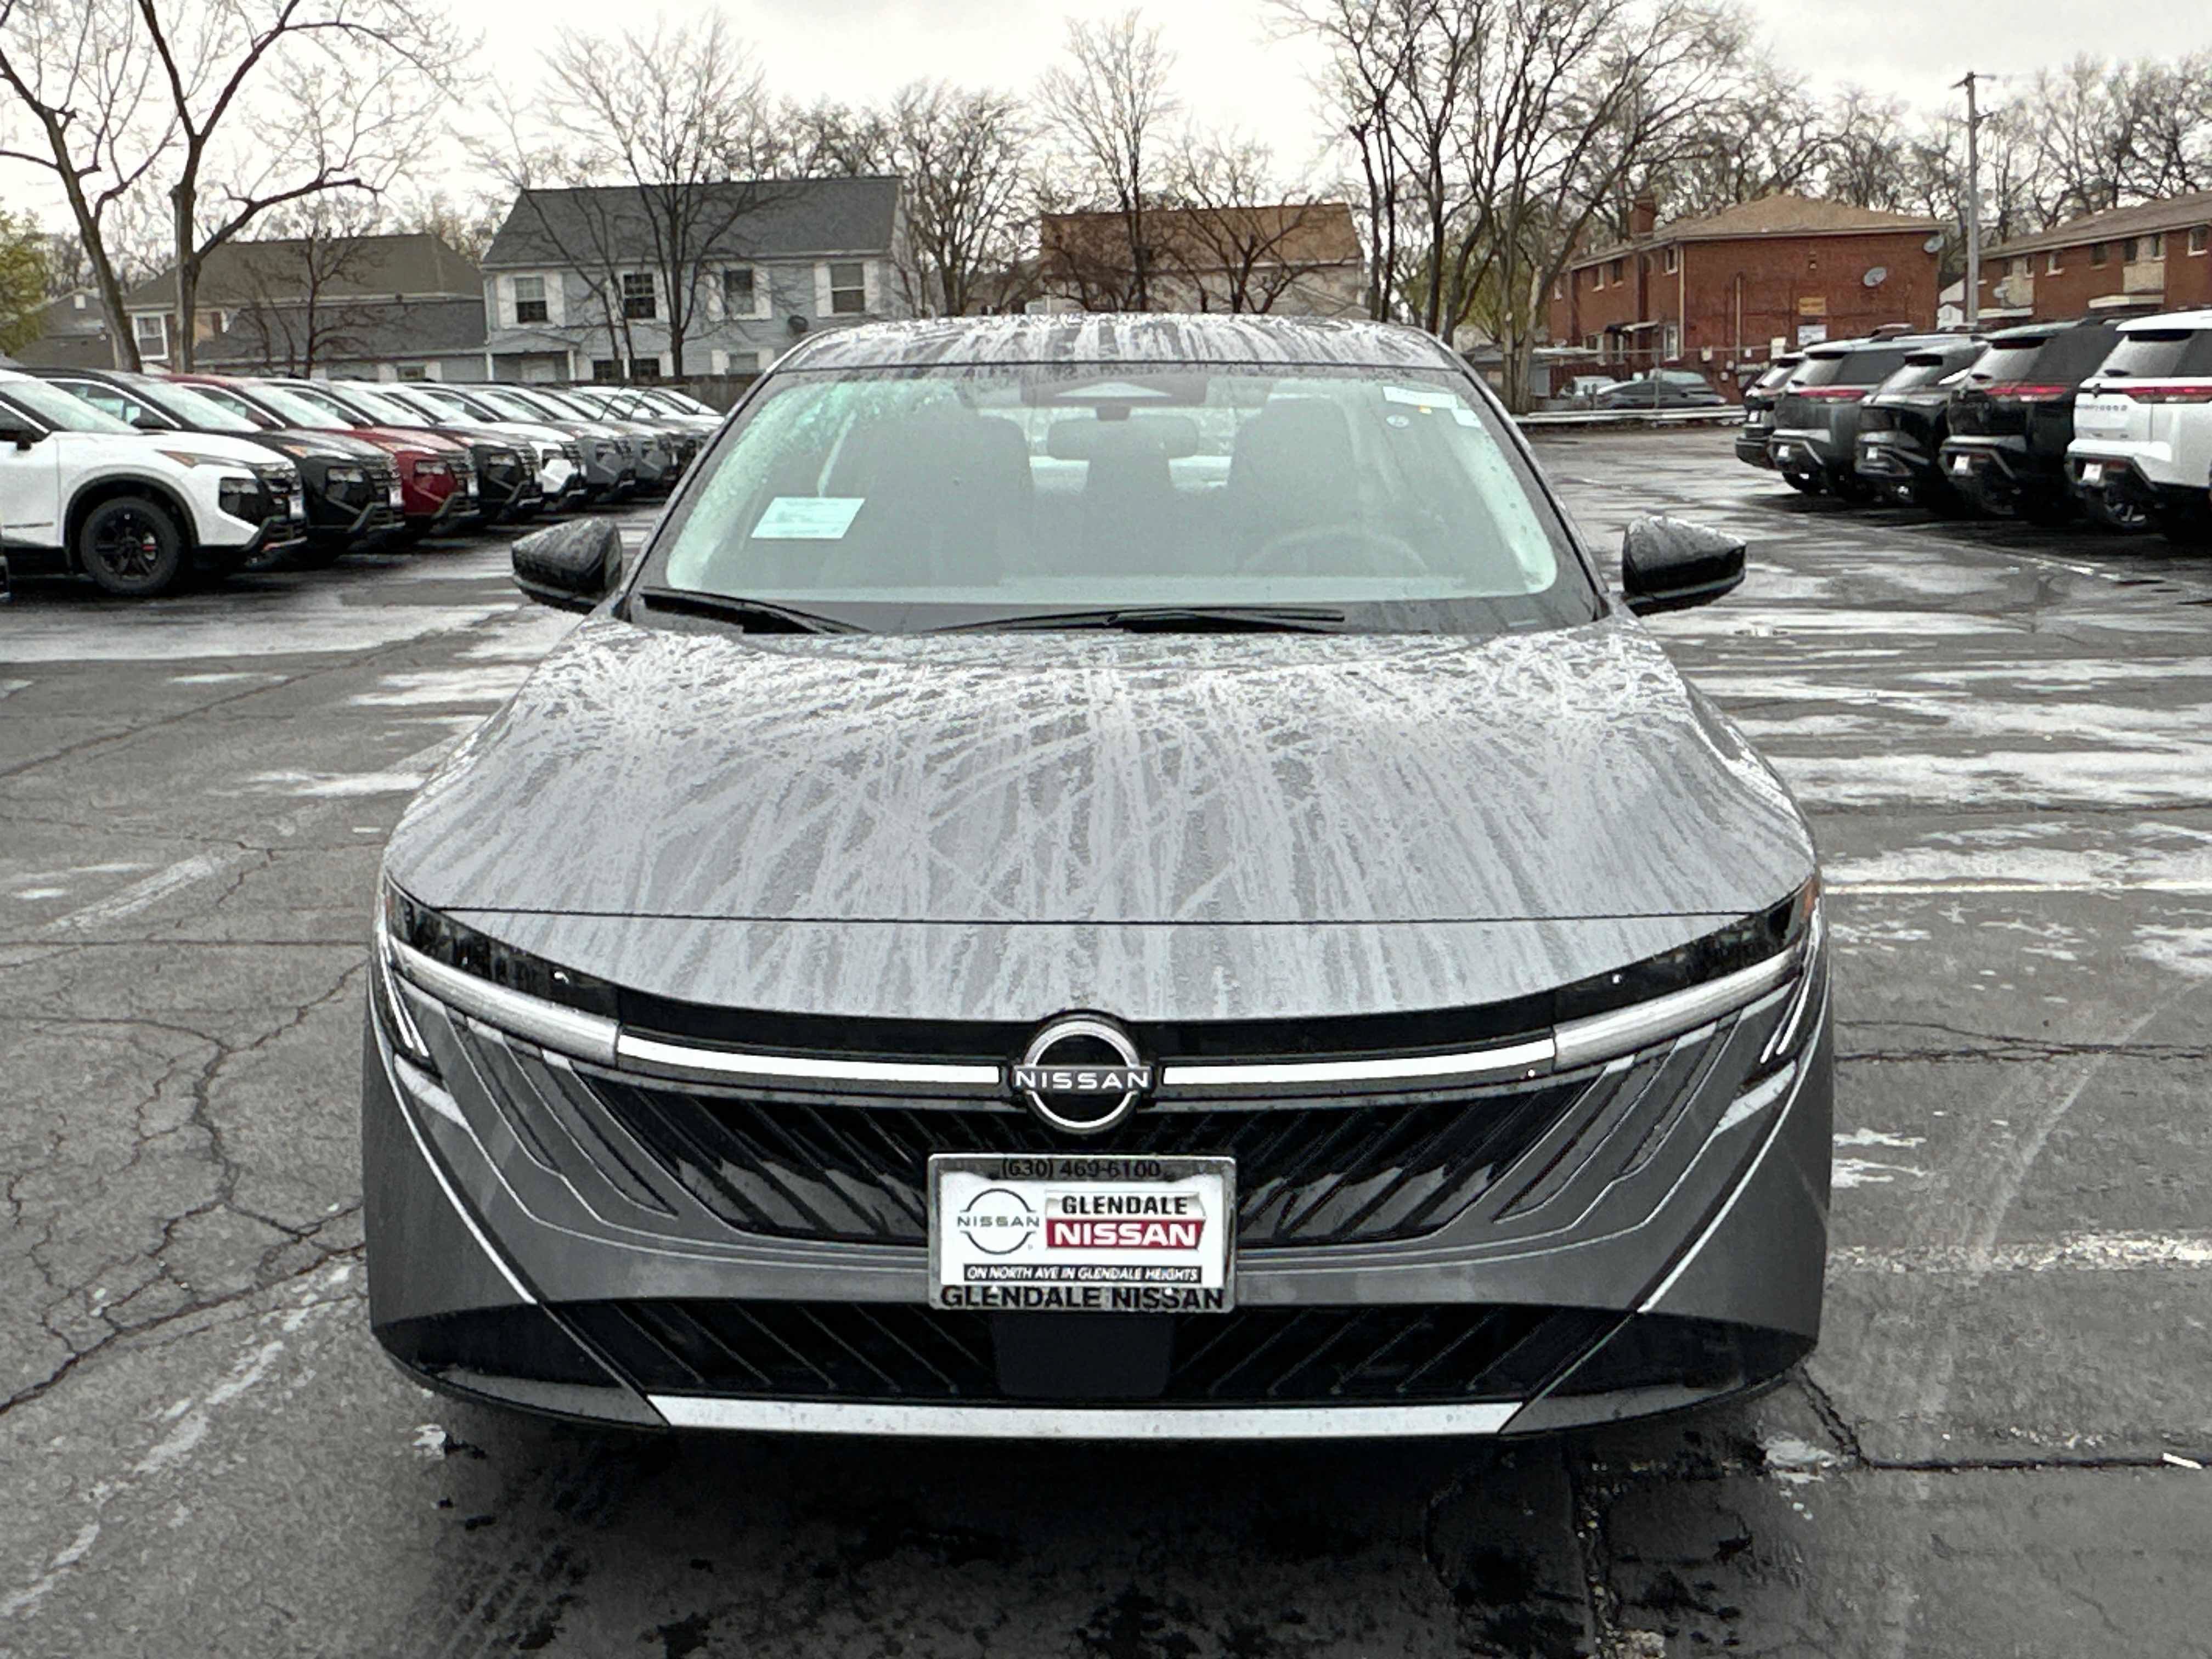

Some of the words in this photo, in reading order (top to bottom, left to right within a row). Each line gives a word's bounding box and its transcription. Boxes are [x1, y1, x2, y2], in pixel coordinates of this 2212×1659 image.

[1015, 1071, 1149, 1089] NISSAN
[1002, 1158, 1053, 1179] (630)
[1059, 1159, 1161, 1178] 469-6100
[1062, 1195, 1188, 1215] GLENDALE
[957, 1216, 1040, 1227] NISSAN
[1054, 1222, 1196, 1246] NISSAN
[967, 1266, 988, 1279] ON
[989, 1266, 1033, 1279] NORTH
[1035, 1267, 1059, 1279] AVE
[1060, 1267, 1076, 1279] IN
[1077, 1267, 1142, 1280] GLENDALE
[1144, 1267, 1199, 1282] HEIGHTS
[940, 1285, 1102, 1307] GLENDALE
[1111, 1287, 1223, 1309] NISSAN
